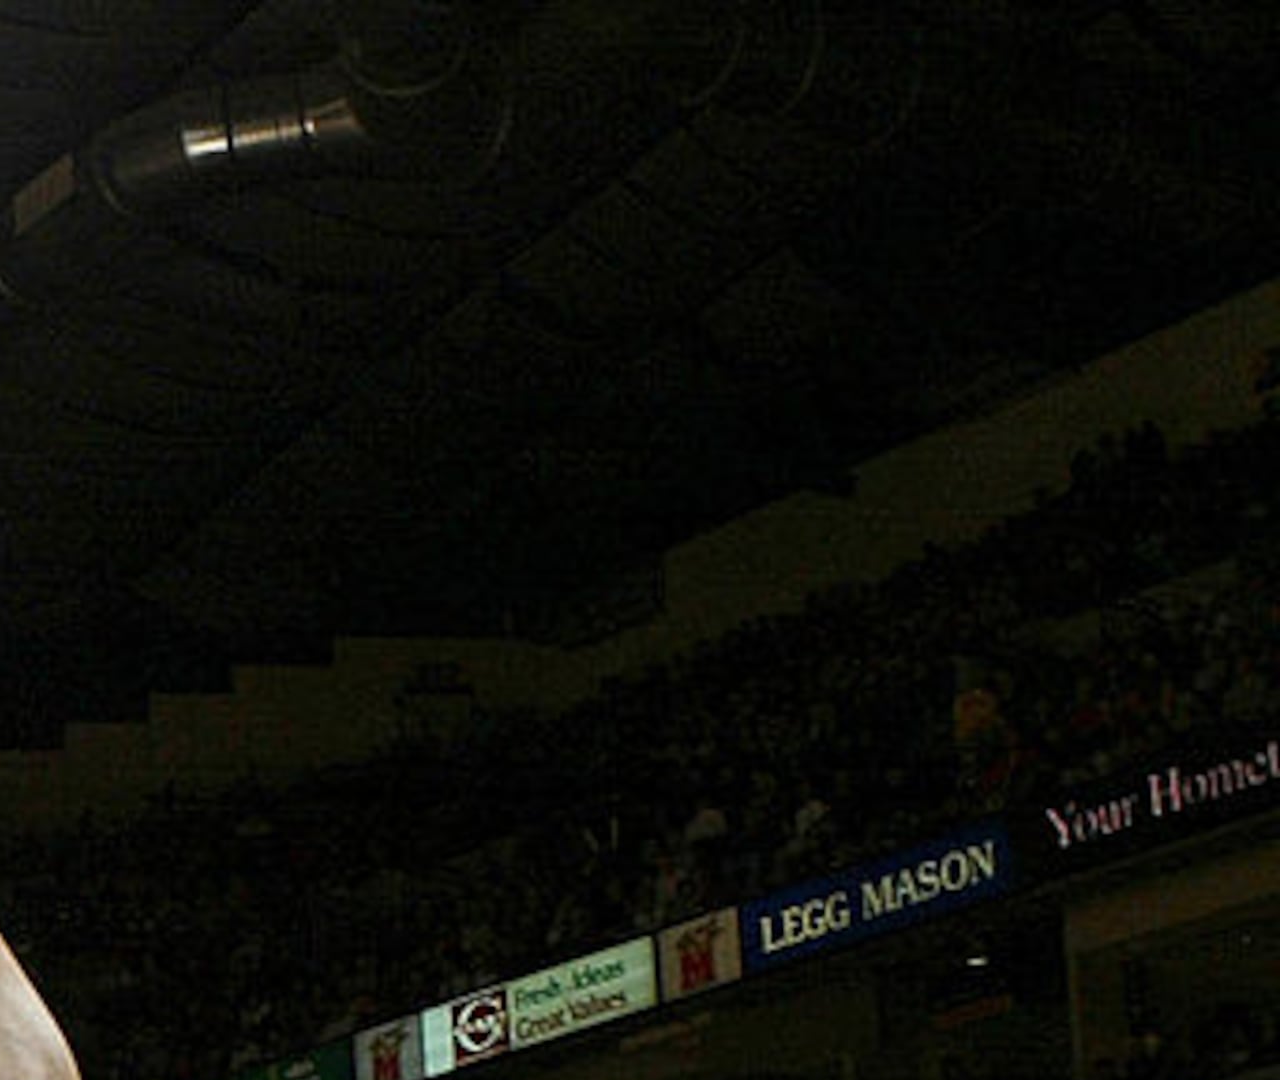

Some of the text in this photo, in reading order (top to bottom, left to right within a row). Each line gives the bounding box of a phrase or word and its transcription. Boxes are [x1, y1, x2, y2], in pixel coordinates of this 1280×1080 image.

[1045, 792, 1139, 850] Your
[759, 841, 996, 955] LEGG MASON
